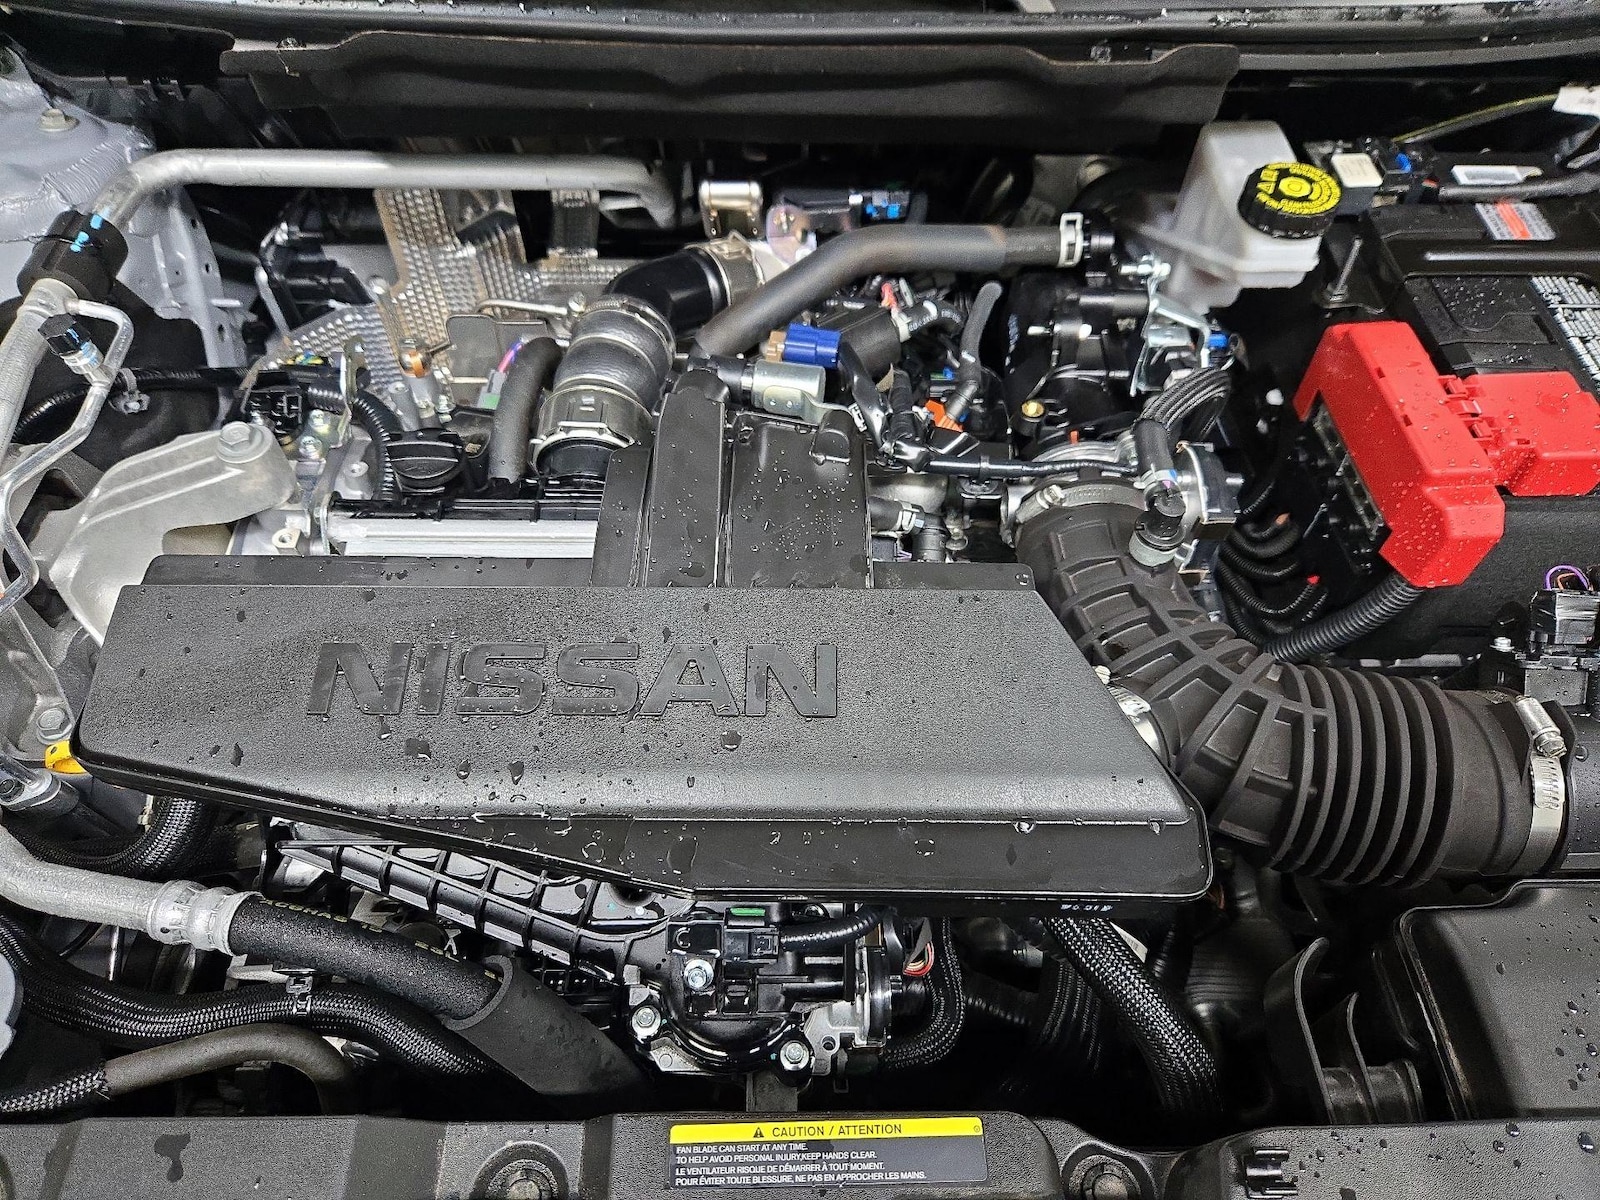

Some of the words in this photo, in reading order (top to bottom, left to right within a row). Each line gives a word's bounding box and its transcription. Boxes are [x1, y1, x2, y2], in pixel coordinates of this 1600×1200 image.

[307, 642, 838, 718] NISSAN
[772, 1126, 825, 1137] CAUTION
[829, 1126, 834, 1136] /
[838, 1124, 902, 1136] ATTENTION
[676, 1146, 692, 1154] FAN
[693, 1145, 718, 1154] BLADE
[719, 1144, 736, 1153] CAN
[737, 1144, 760, 1152] START
[761, 1144, 771, 1152] AT
[772, 1143, 787, 1151] ANY
[789, 1143, 808, 1151] TIME.
[676, 1156, 688, 1164] TO
[688, 1155, 708, 1164] HELP
[709, 1155, 733, 1163] AVOID
[734, 1154, 774, 1162] PERSONAL
[822, 1152, 850, 1160] HANDS
[850, 1151, 877, 1159] CLEAR.
[676, 1168, 686, 1176] LE
[687, 1166, 736, 1175] VENTILATEUR
[736, 1166, 766, 1174] RISQUE
[766, 1165, 778, 1173] DE
[780, 1162, 821, 1172] DÉMARRER
[822, 1161, 828, 1171] À
[830, 1163, 849, 1171] TOUT
[850, 1162, 885, 1170] MOMENT.
[676, 1178, 698, 1186] POUR
[699, 1176, 726, 1185] ÉVITER
[726, 1176, 752, 1184] TOUTE
[752, 1176, 794, 1184] BLESSURE,
[795, 1174, 806, 1182] NE
[808, 1174, 823, 1182] PAS
[836, 1172, 884, 1181] APPROCHER
[884, 1172, 900, 1180] LES
[900, 1171, 927, 1179] MAINS.
